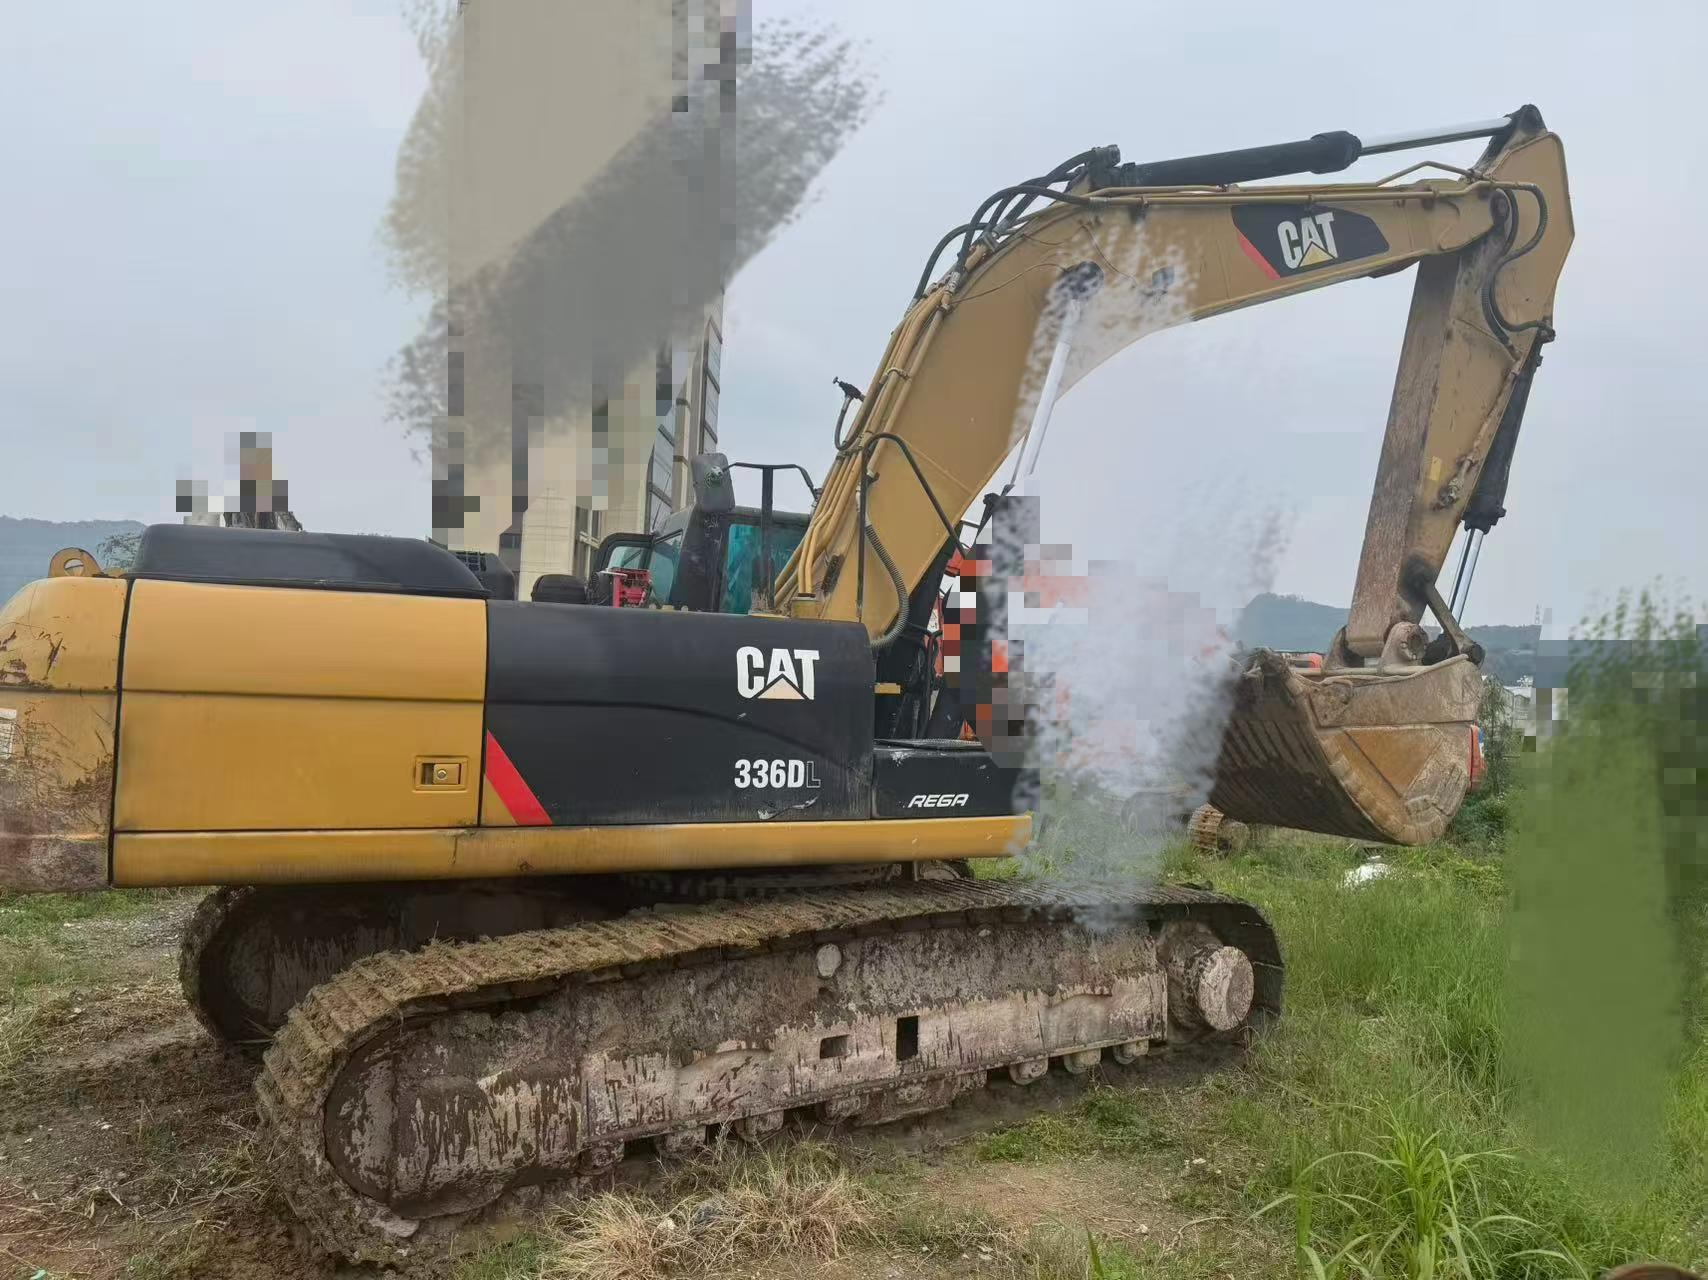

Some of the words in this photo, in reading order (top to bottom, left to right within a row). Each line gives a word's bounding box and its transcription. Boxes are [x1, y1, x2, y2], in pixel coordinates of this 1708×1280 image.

[1277, 211, 1338, 269] CAT
[736, 646, 820, 700] CAT
[907, 793, 969, 808] REGA
